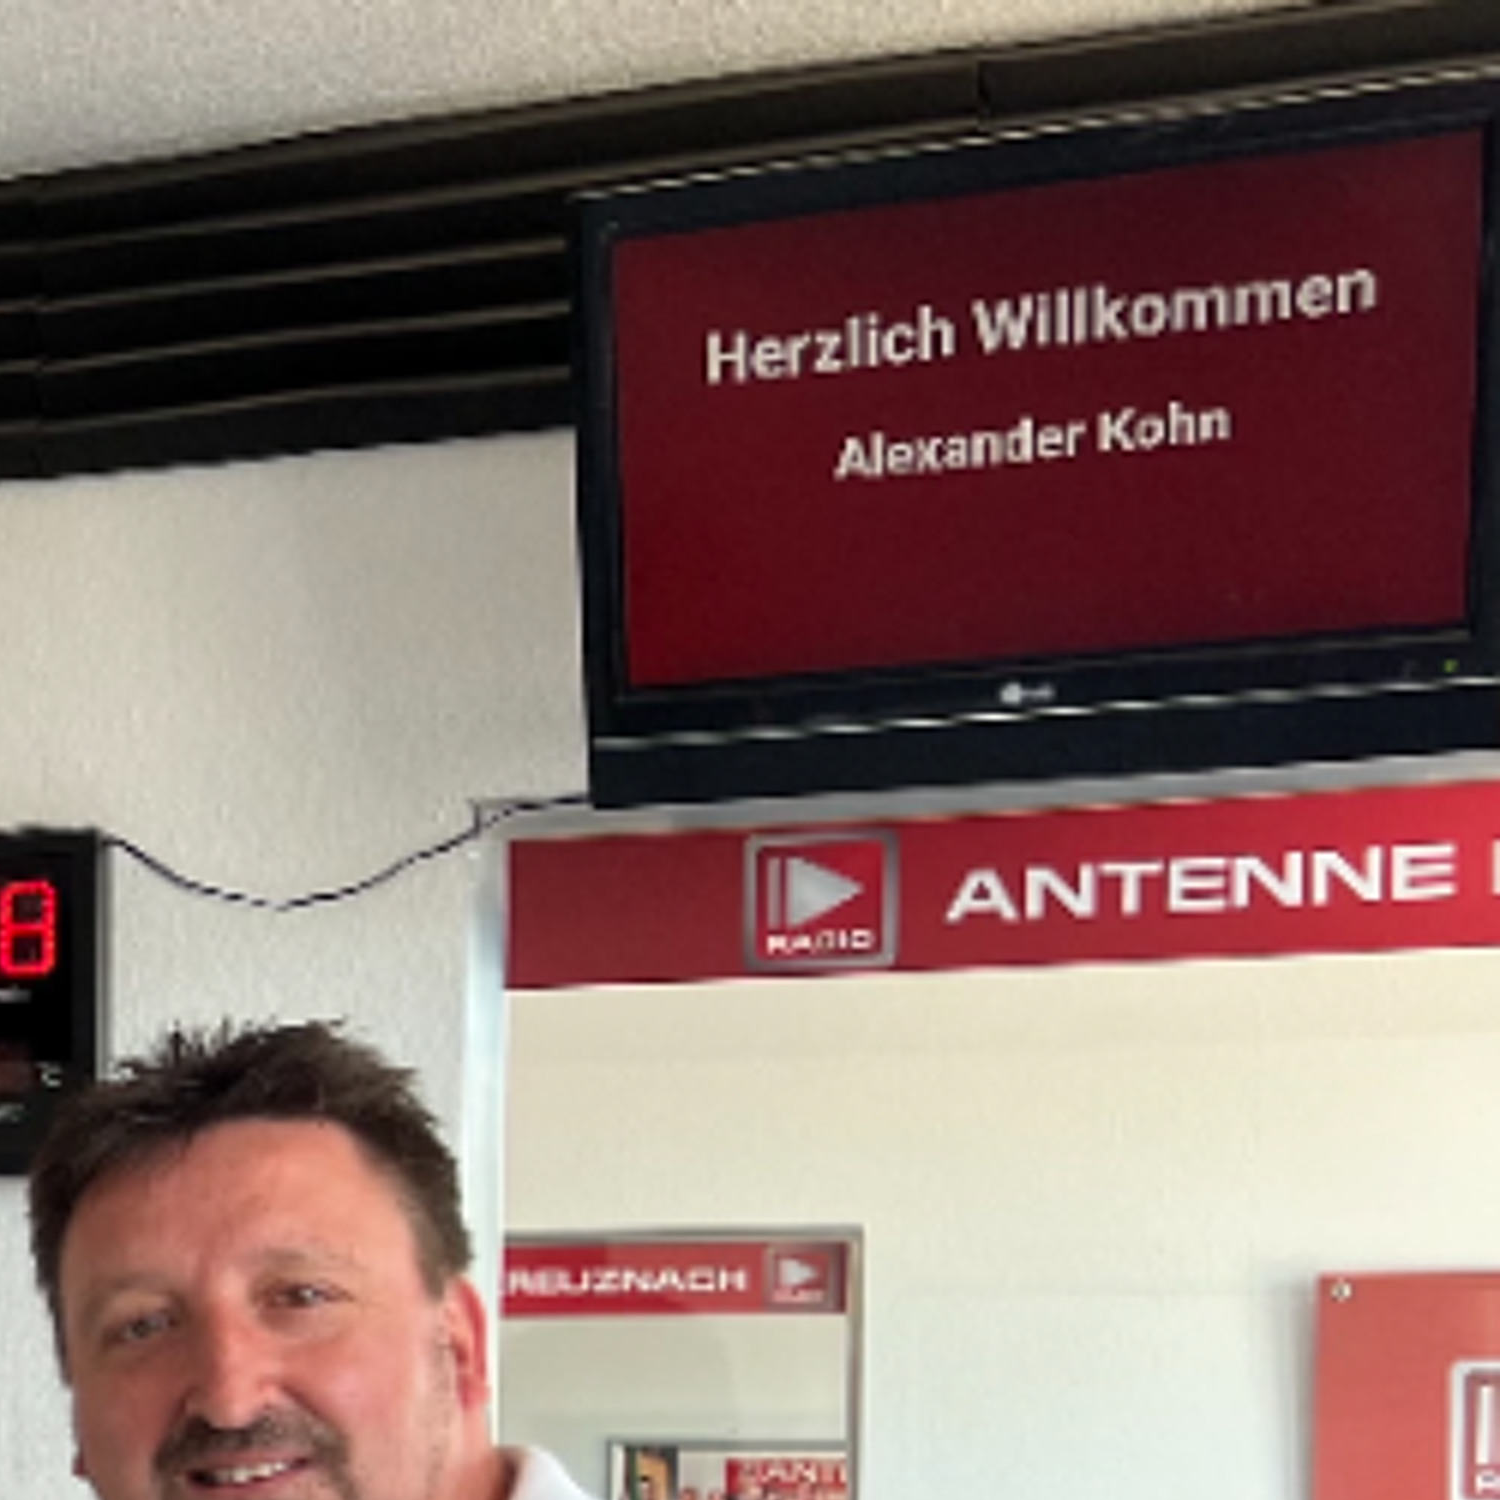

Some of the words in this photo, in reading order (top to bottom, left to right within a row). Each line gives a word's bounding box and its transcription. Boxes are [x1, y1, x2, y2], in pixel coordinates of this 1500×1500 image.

[705, 304, 956, 386] Herzlich
[972, 267, 1377, 354] Willkommen
[833, 415, 1086, 480] Alexander
[1098, 400, 1231, 452] Kohn
[945, 842, 1457, 924] ANTENNE
